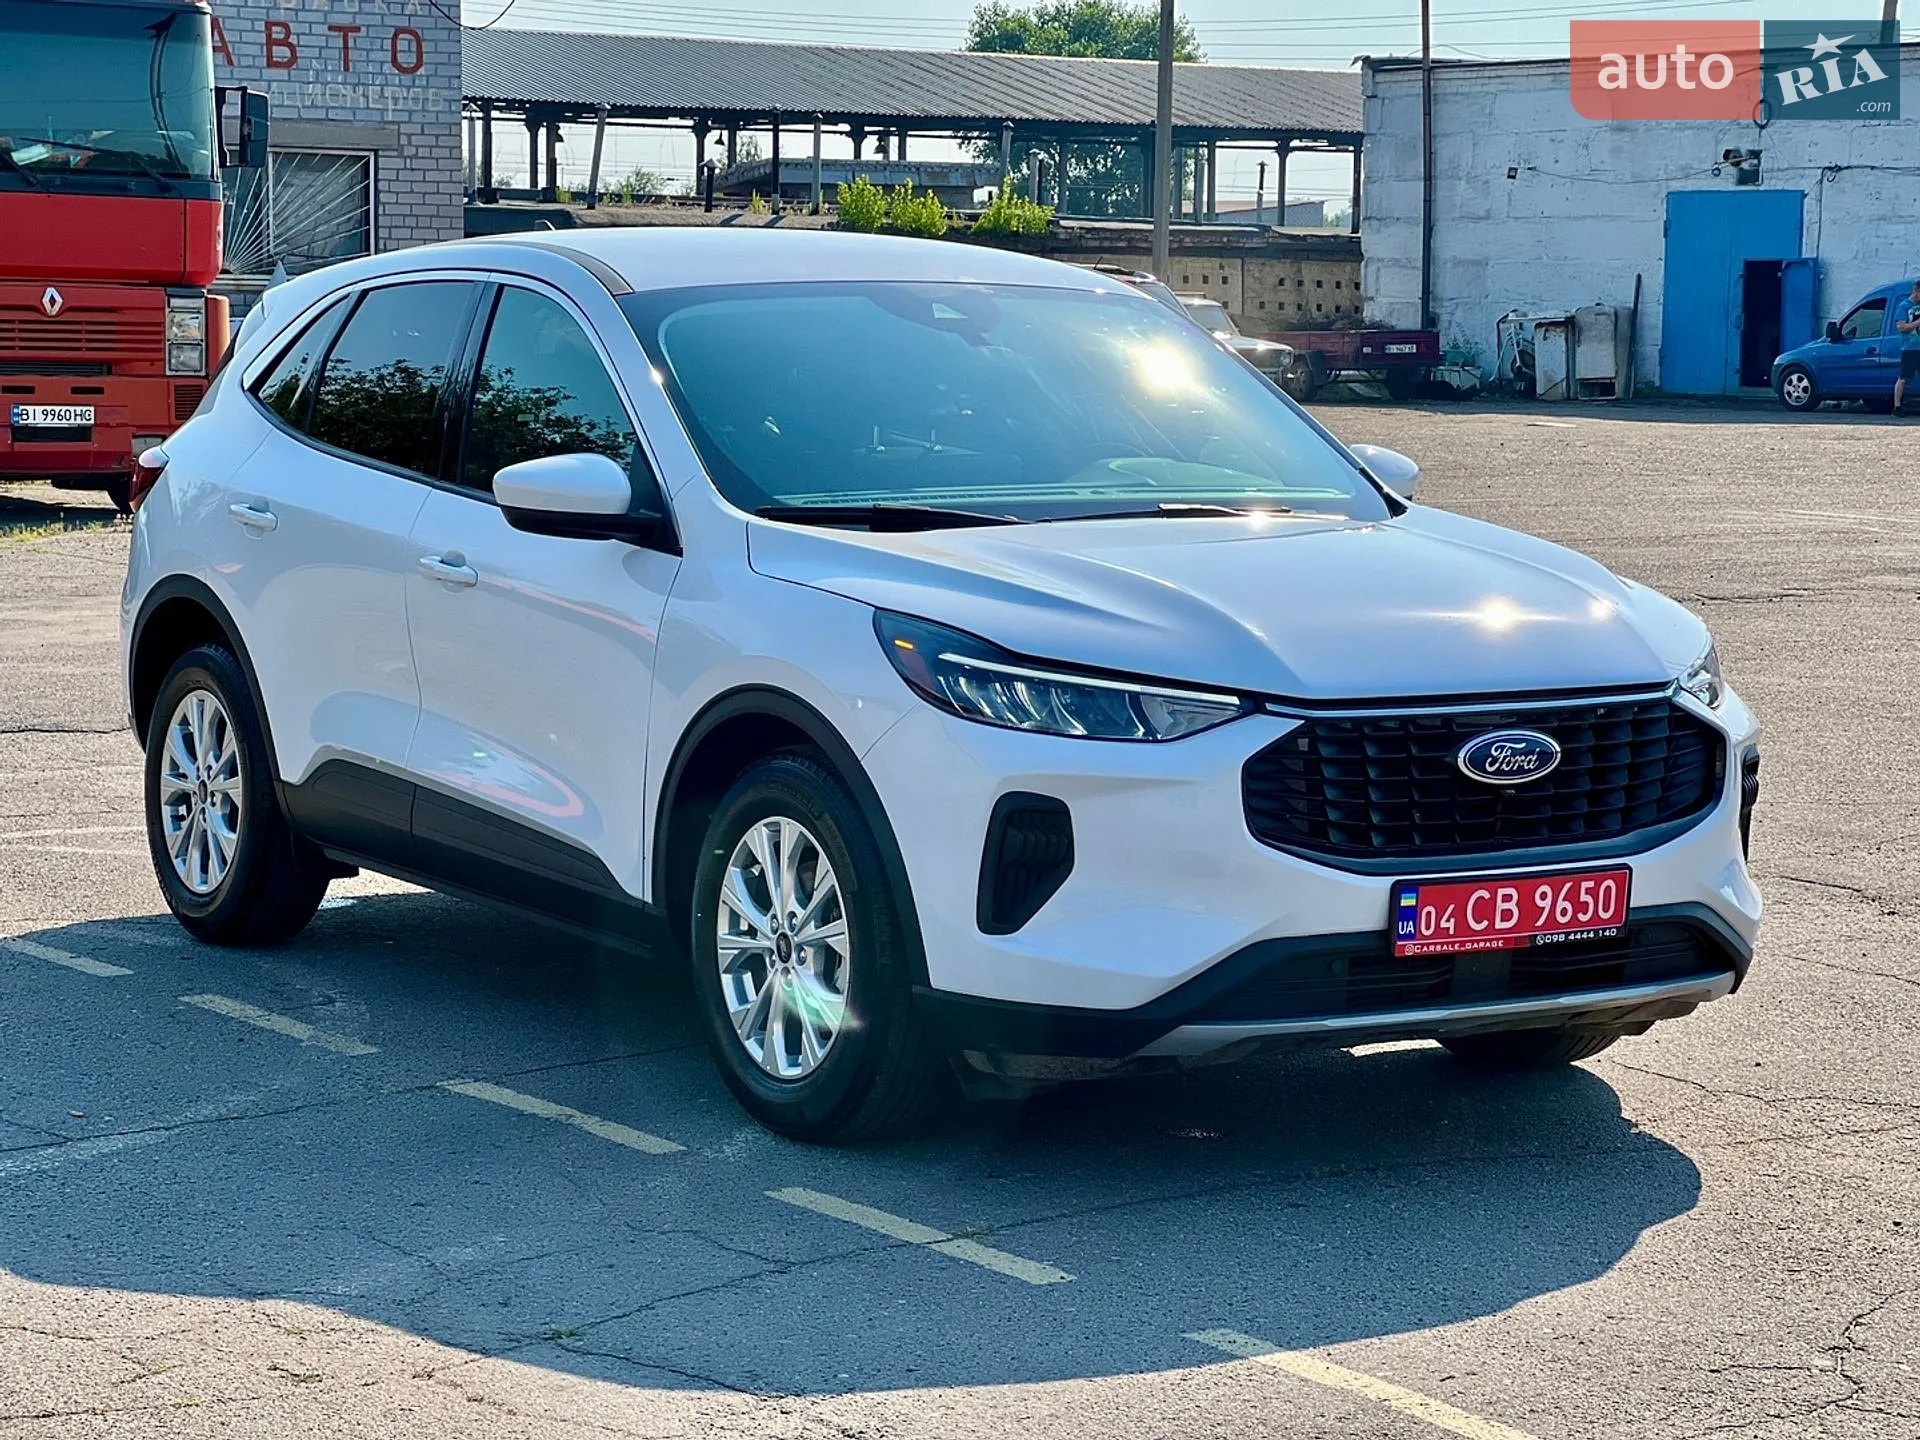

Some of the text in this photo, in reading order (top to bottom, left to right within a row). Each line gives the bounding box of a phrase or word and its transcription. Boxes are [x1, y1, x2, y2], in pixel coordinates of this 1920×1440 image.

[210, 16, 424, 75] АВТО
[41, 408, 72, 422] 9960
[1485, 742, 1540, 772] Ford
[1420, 879, 1617, 936] 04 CB 9650
[1398, 920, 1415, 936] UA
[1568, 931, 1595, 940] 4444
[1599, 928, 1617, 937] 140
